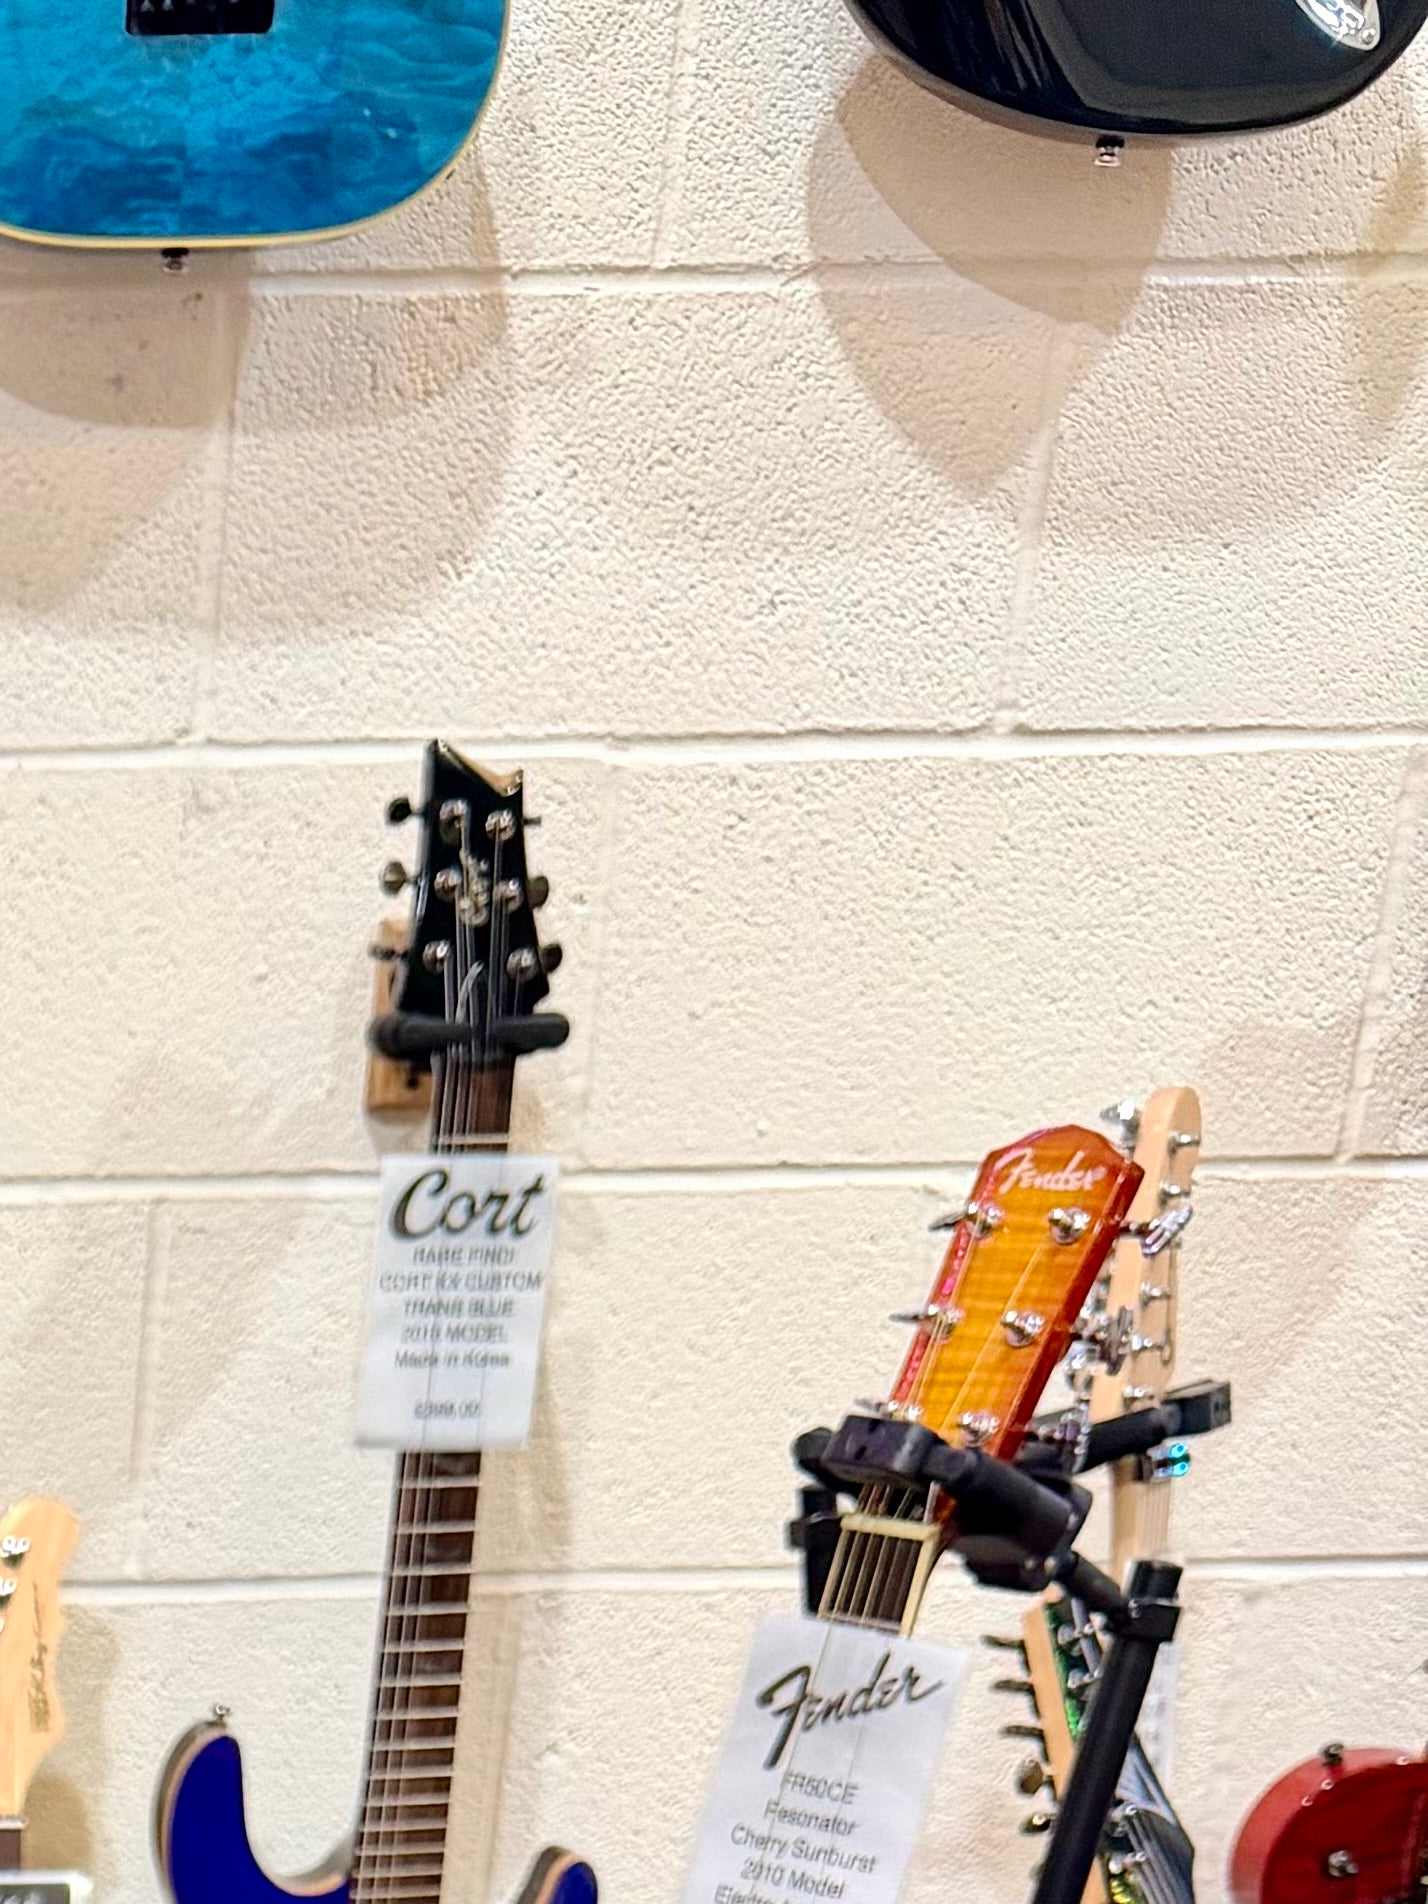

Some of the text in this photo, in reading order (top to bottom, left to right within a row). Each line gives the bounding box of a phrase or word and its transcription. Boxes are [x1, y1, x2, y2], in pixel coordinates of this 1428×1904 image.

[993, 1147, 1095, 1195] Fender
[389, 1167, 547, 1241] Cort
[756, 1650, 944, 1771] Fender
[763, 1800, 860, 1837] Resonator
[730, 1823, 878, 1875] Cherry Sunburst
[787, 1867, 846, 1900] Model
